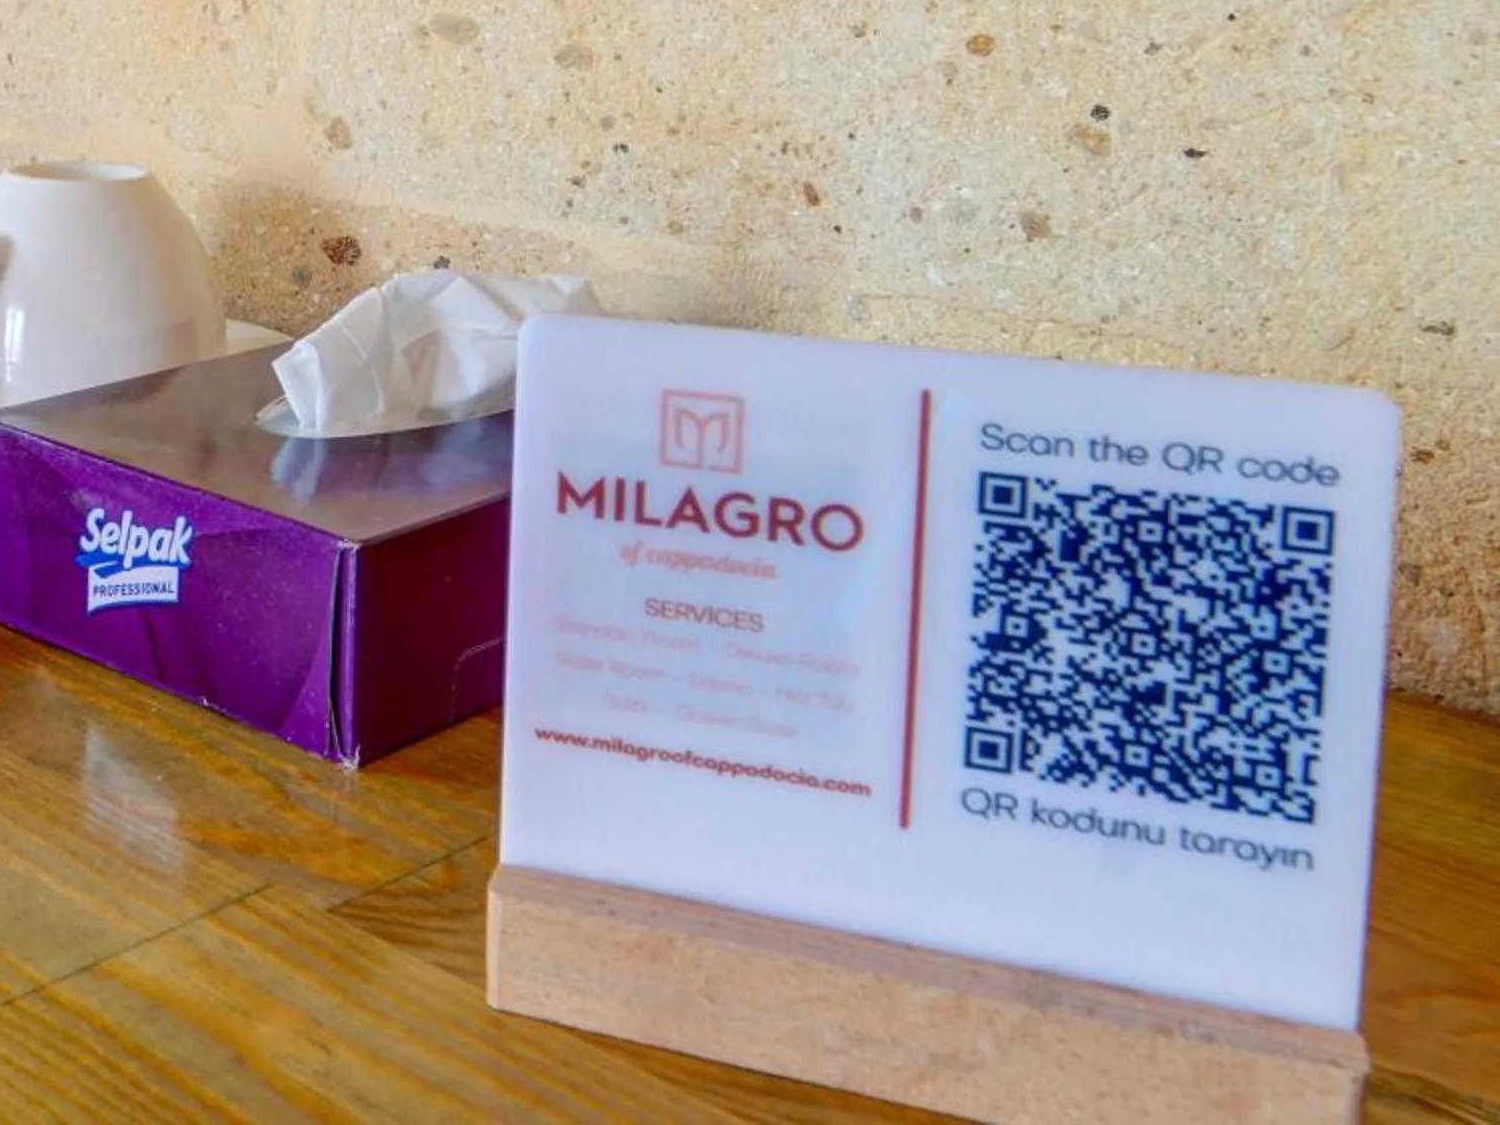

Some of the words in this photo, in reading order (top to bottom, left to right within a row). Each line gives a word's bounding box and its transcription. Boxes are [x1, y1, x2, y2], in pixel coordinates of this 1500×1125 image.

[979, 423, 1075, 457] Scan
[1088, 435, 1150, 467] the
[1161, 441, 1225, 475] QR
[1236, 454, 1341, 488] code
[79, 507, 193, 570] Selpak
[555, 469, 866, 553] MILAGRO
[92, 581, 175, 597] PROFESSIONAL
[959, 785, 1019, 821] QR
[1029, 797, 1167, 847] kodunu
